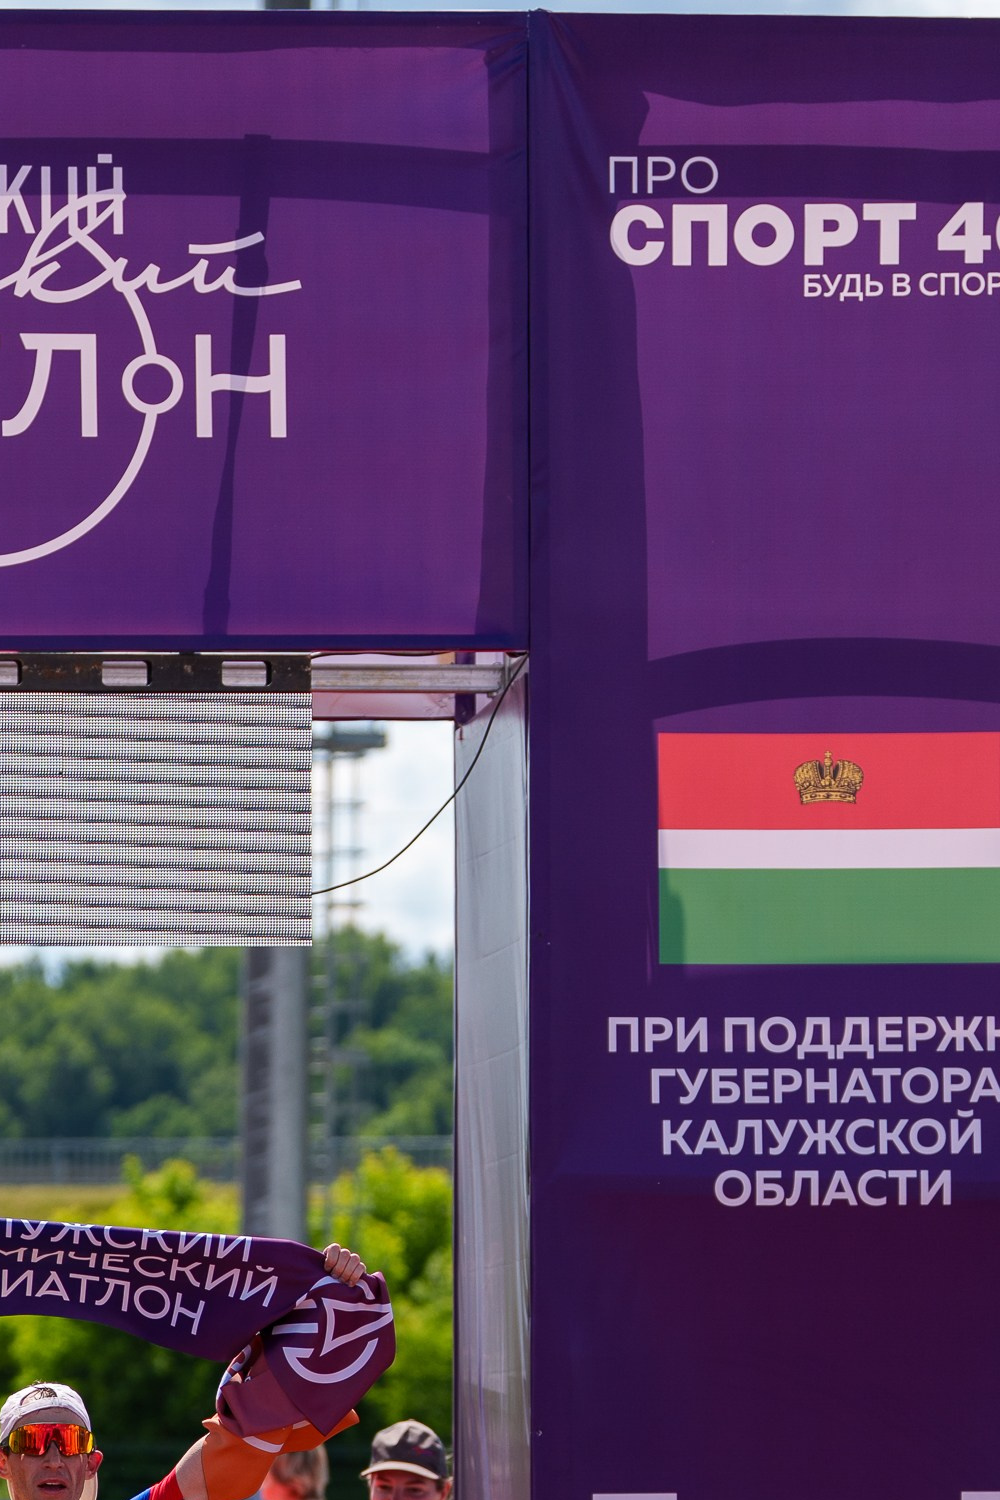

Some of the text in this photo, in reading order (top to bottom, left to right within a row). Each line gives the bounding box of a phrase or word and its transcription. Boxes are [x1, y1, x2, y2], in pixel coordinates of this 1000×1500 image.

[608, 156, 719, 194] ПРО
[609, 202, 1000, 267] СПОРТ 4
[803, 272, 884, 301] БУДЬ
[892, 273, 912, 297] В
[607, 1016, 709, 1053] ПРИ
[650, 1067, 1000, 1105] ГУБЕРНАТОРА
[662, 1109, 983, 1156] КАЛУЖСКОЙ
[714, 1169, 953, 1207] ОБЛАСТИ
